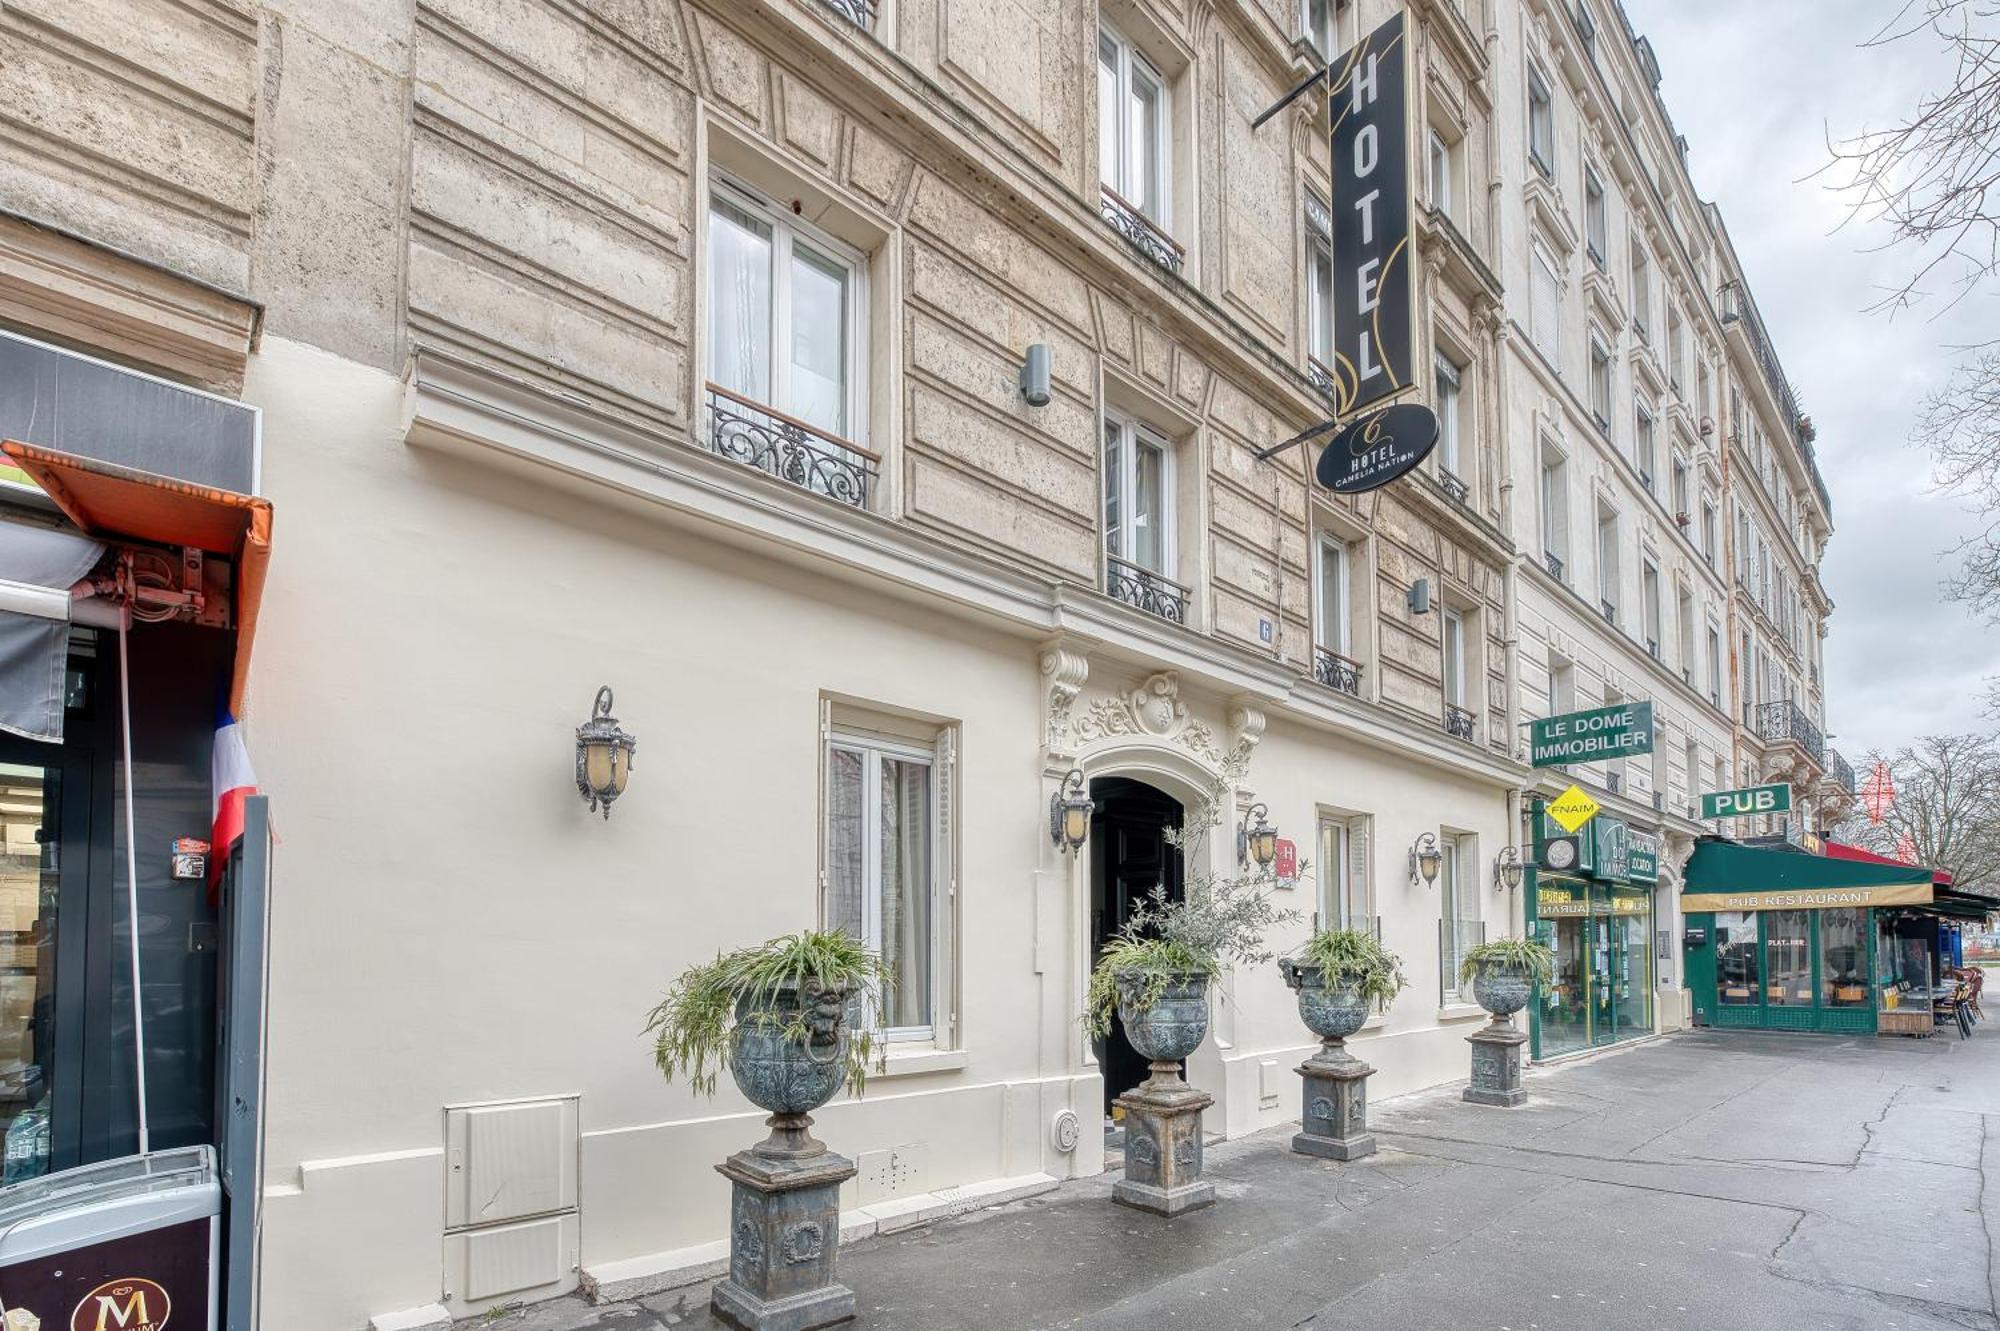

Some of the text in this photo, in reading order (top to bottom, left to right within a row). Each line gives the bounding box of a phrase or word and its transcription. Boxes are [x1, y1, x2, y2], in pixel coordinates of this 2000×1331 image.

[1352, 53, 1381, 382] HOTEL
[1377, 450, 1415, 471] NATION
[1545, 711, 1635, 738] LE DOME
[1535, 731, 1648, 760] IMMOBILIER
[1551, 804, 1595, 814] FNAIM
[1715, 790, 1776, 814] PUB
[1728, 891, 1872, 907] PUB RESTAURANT
